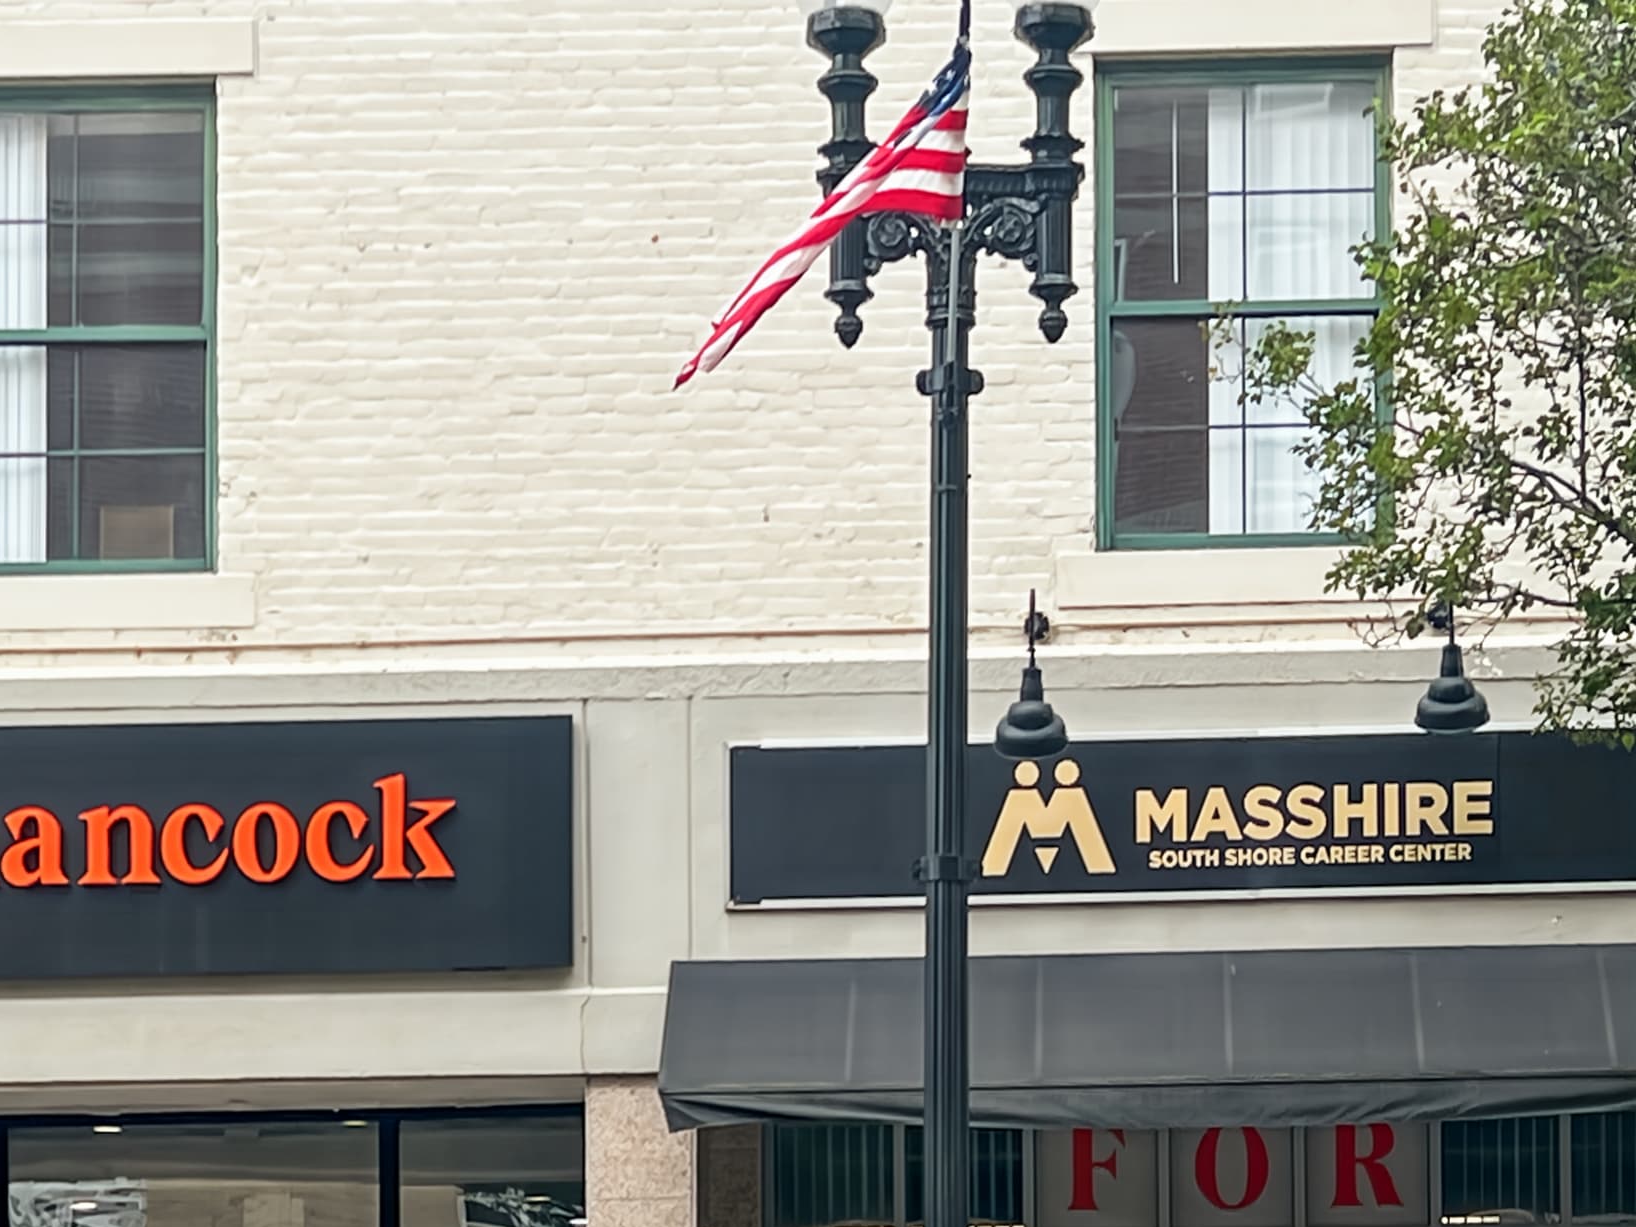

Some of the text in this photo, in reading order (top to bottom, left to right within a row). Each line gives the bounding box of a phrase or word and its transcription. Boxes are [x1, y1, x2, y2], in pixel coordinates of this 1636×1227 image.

[1134, 780, 1494, 844] MASSHIRE
[1148, 842, 1472, 869] SOUTH SHORE CAREER CENTER
[1066, 1121, 1405, 1213] FOR
